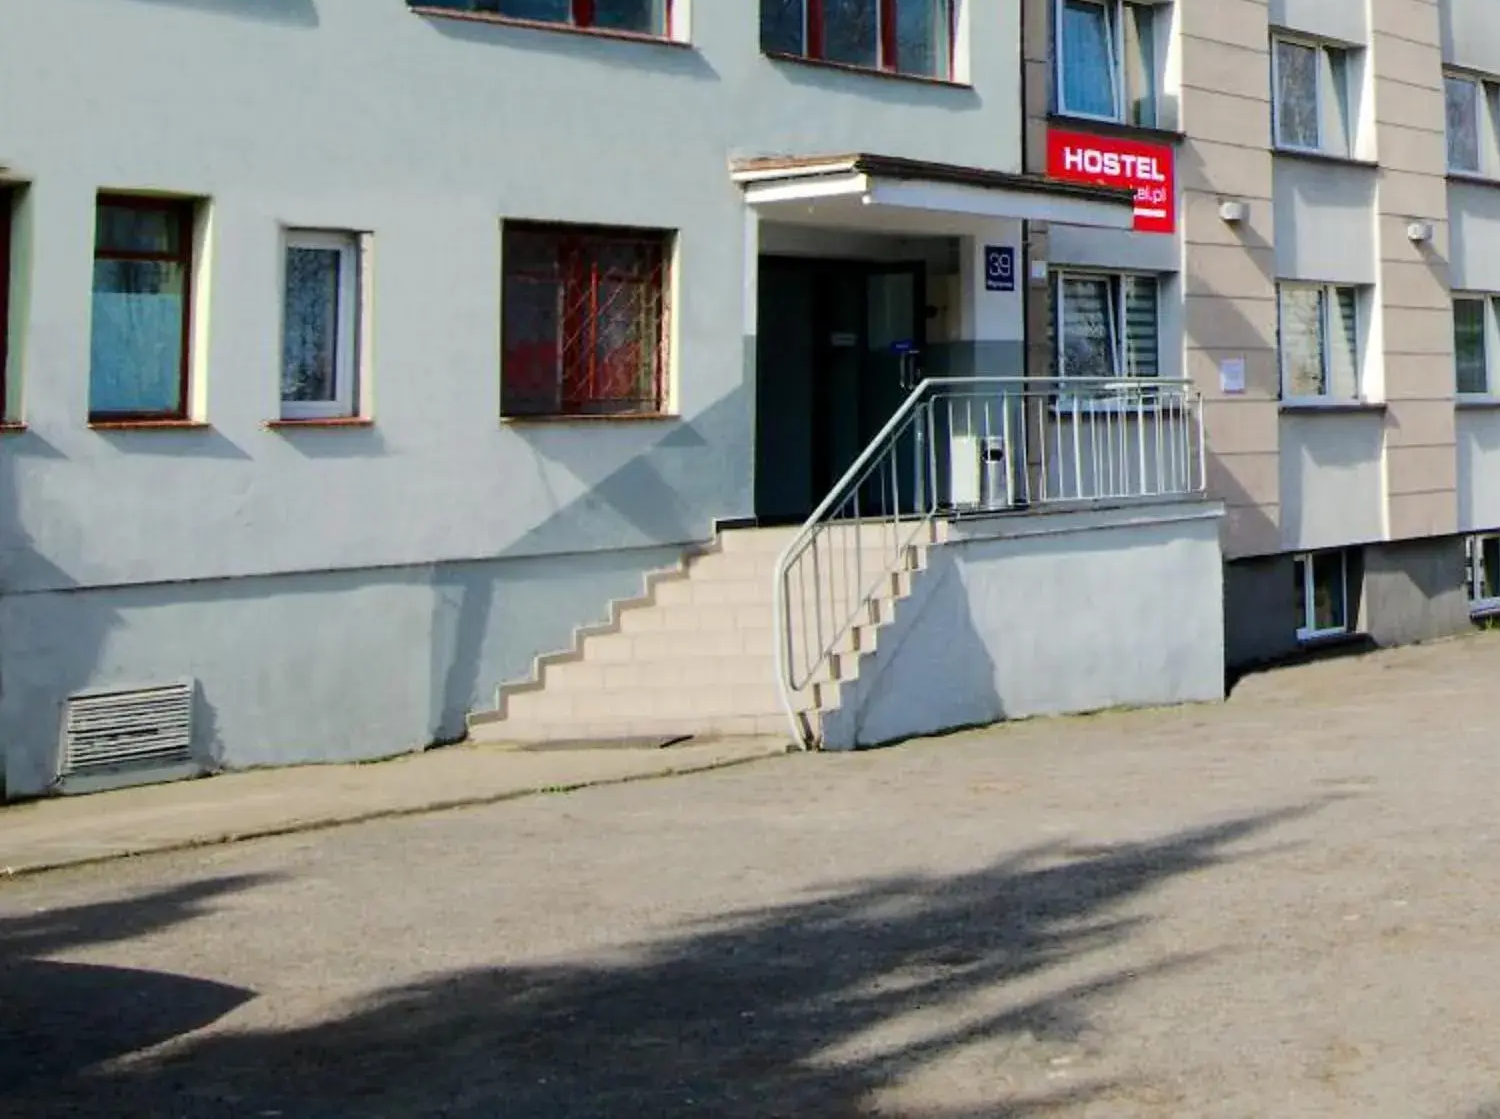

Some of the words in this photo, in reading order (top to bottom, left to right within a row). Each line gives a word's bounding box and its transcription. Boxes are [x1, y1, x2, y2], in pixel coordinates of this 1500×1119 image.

[1064, 147, 1165, 181] HOSTEL
[1132, 185, 1167, 205] el.pl
[989, 252, 1010, 276] 39
